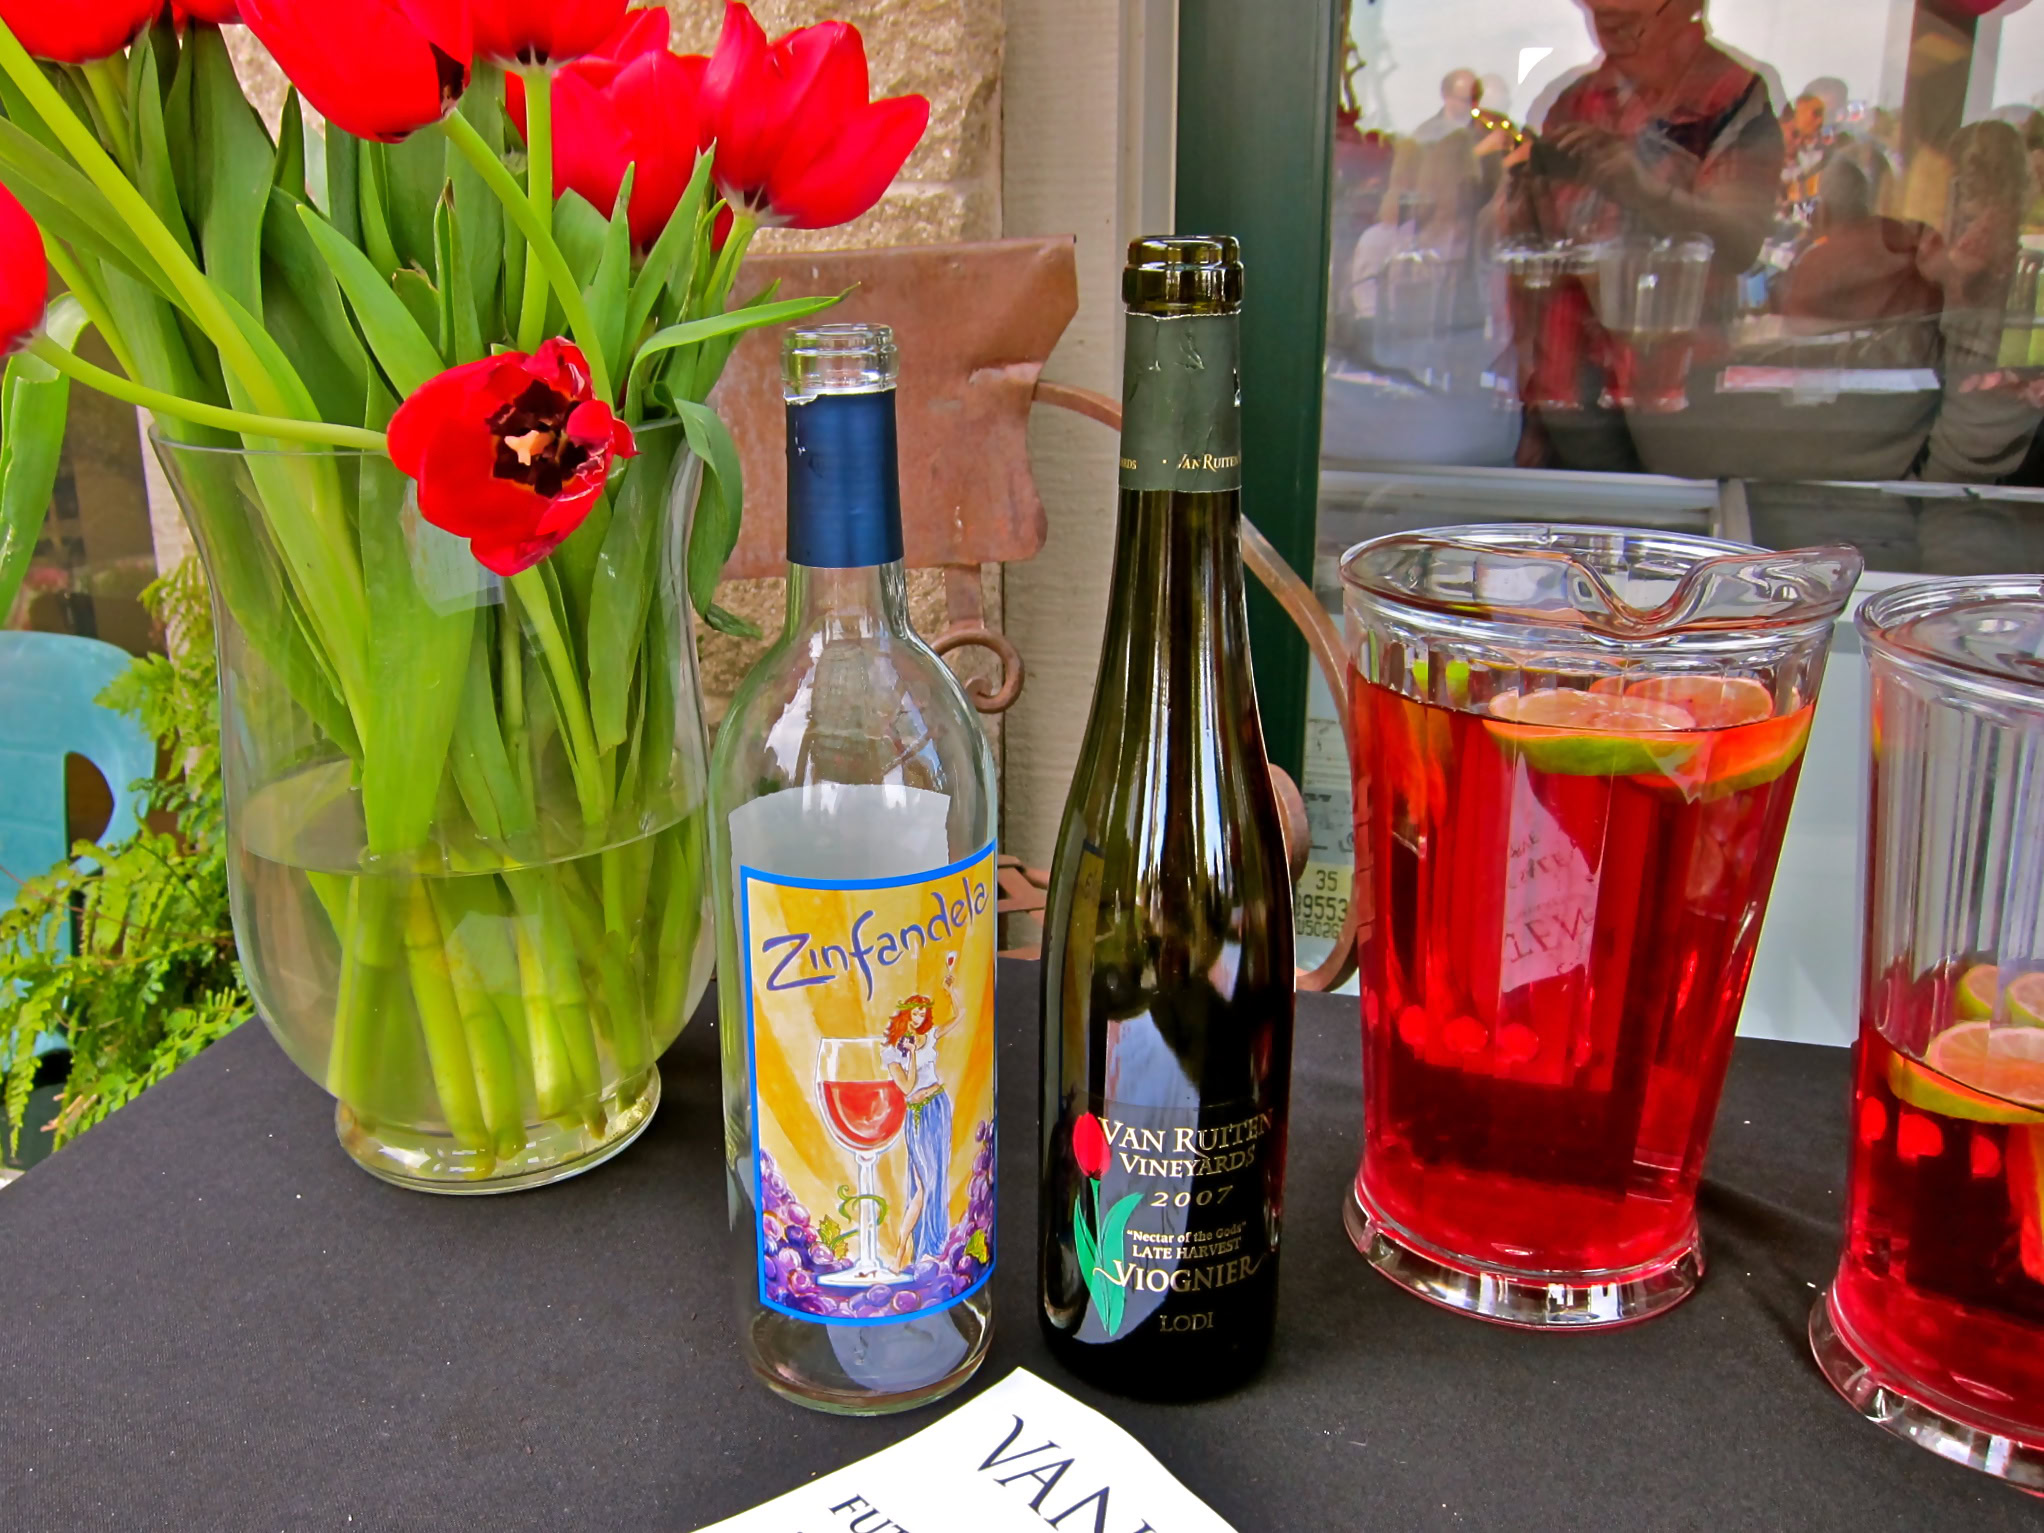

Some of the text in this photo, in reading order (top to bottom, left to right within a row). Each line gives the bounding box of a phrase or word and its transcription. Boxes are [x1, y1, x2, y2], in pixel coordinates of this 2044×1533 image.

[1316, 869, 1338, 892] 35
[762, 876, 990, 1002] Zinfandela
[1098, 1108, 1274, 1159] VAN RUITEN
[1118, 1143, 1256, 1179] VINEYARDS
[1151, 1184, 1234, 1208] 2007
[1132, 1236, 1242, 1260] LATE HARVEST
[1177, 1231, 1193, 1244] of
[1193, 1230, 1213, 1243] the
[1093, 1254, 1265, 1293] VIOGNIER
[1159, 1311, 1215, 1333] LODI
